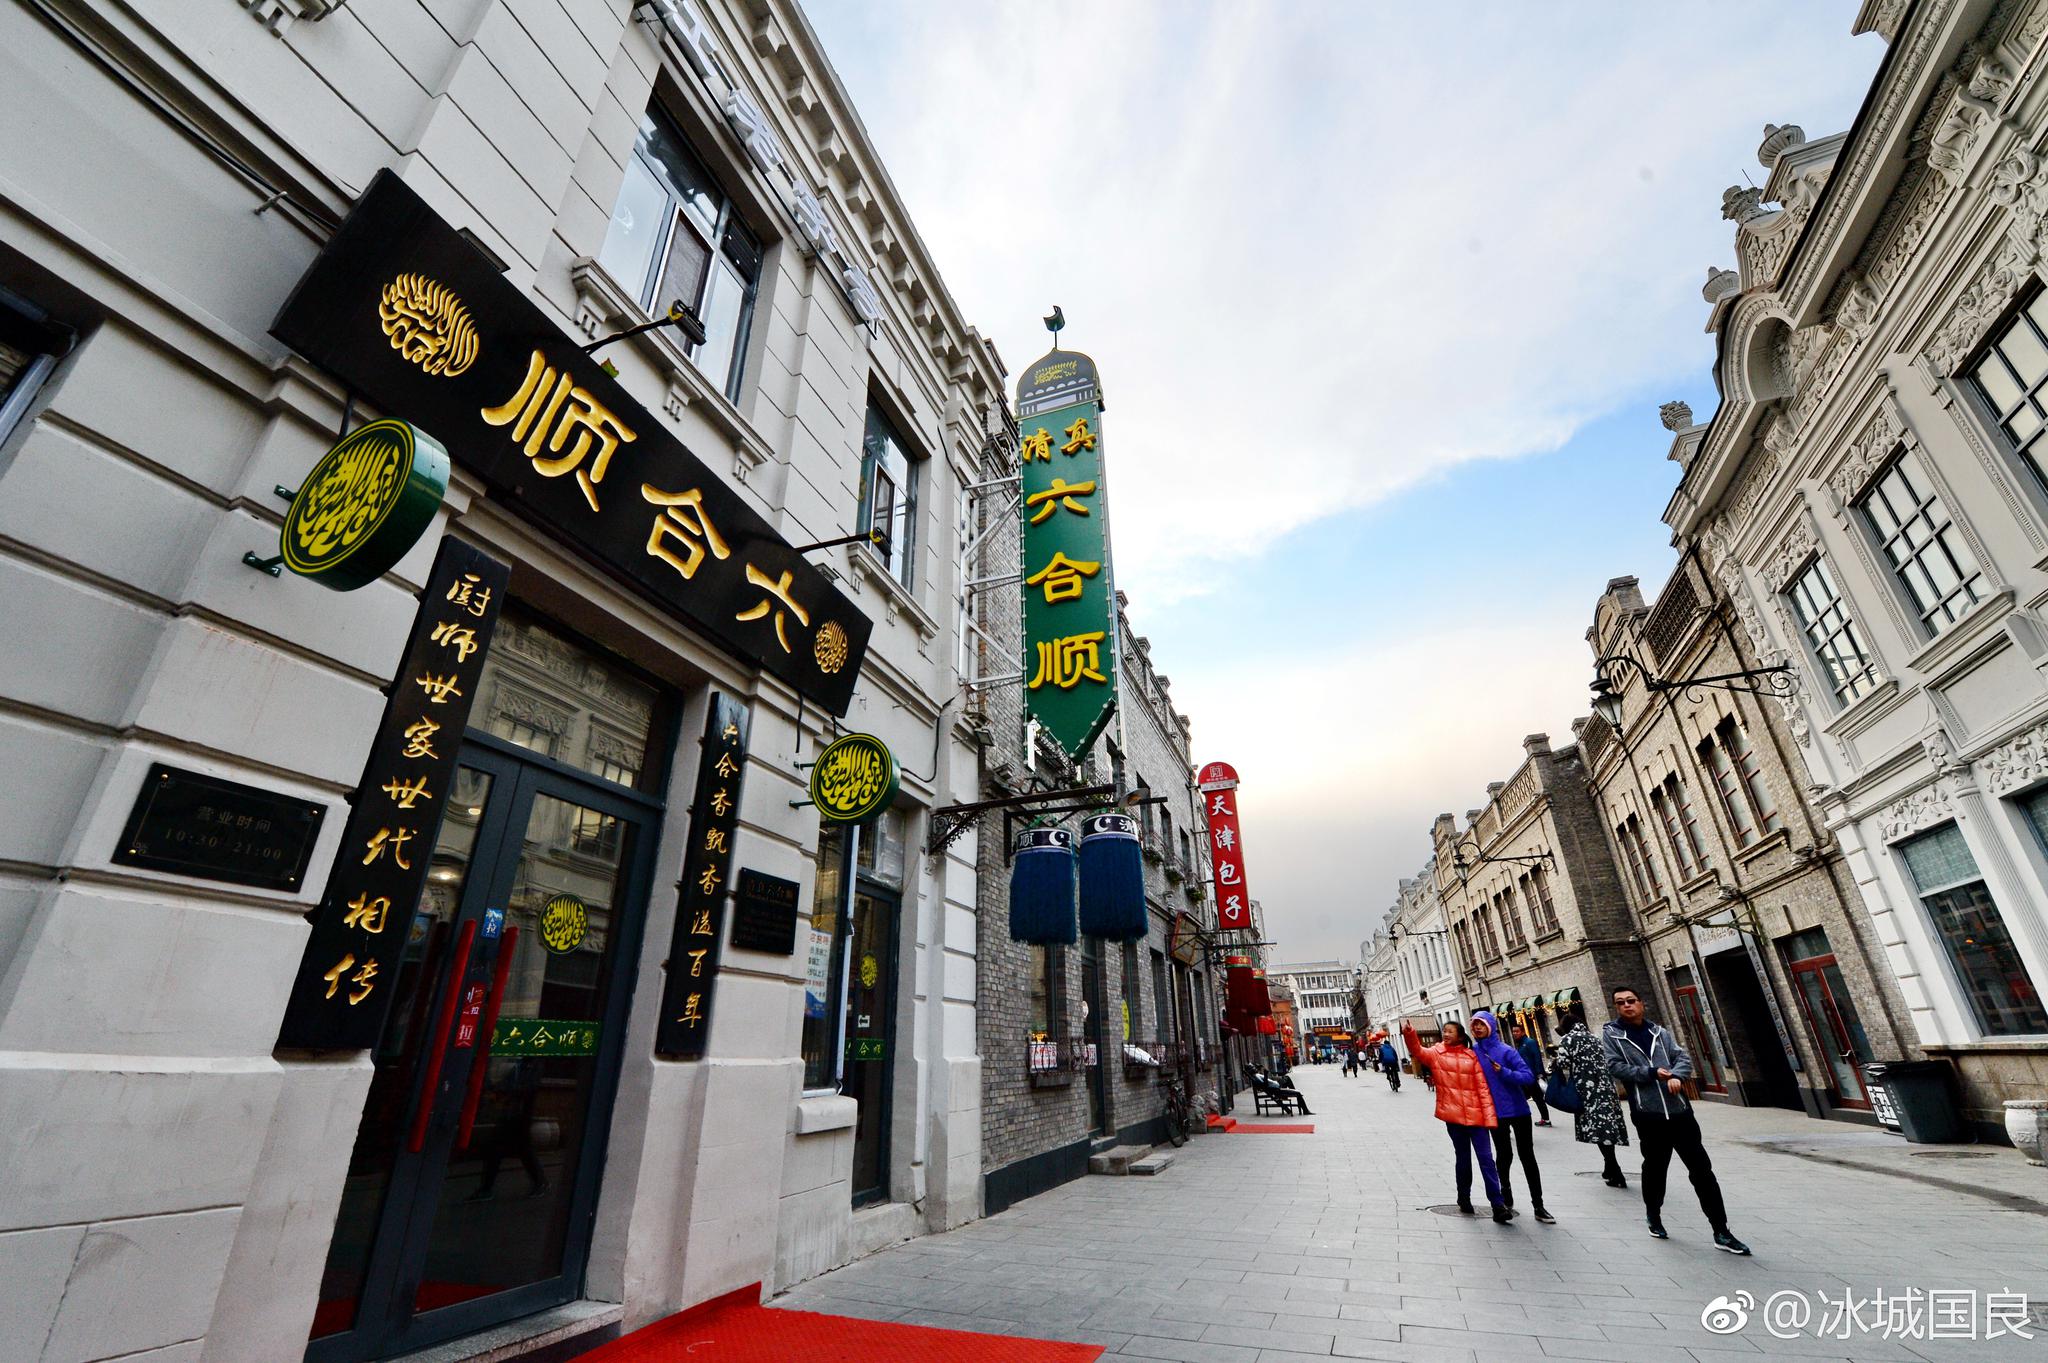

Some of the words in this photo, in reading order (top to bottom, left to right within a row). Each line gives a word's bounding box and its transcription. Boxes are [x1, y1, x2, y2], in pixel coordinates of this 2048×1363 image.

[1021, 418, 1097, 464] 清真
[1026, 478, 1108, 691] 六合顺
[196, 806, 273, 833] 营业时间
[324, 573, 491, 1005] 厨师世家世代相传
[1212, 795, 1242, 921] 天津包子
